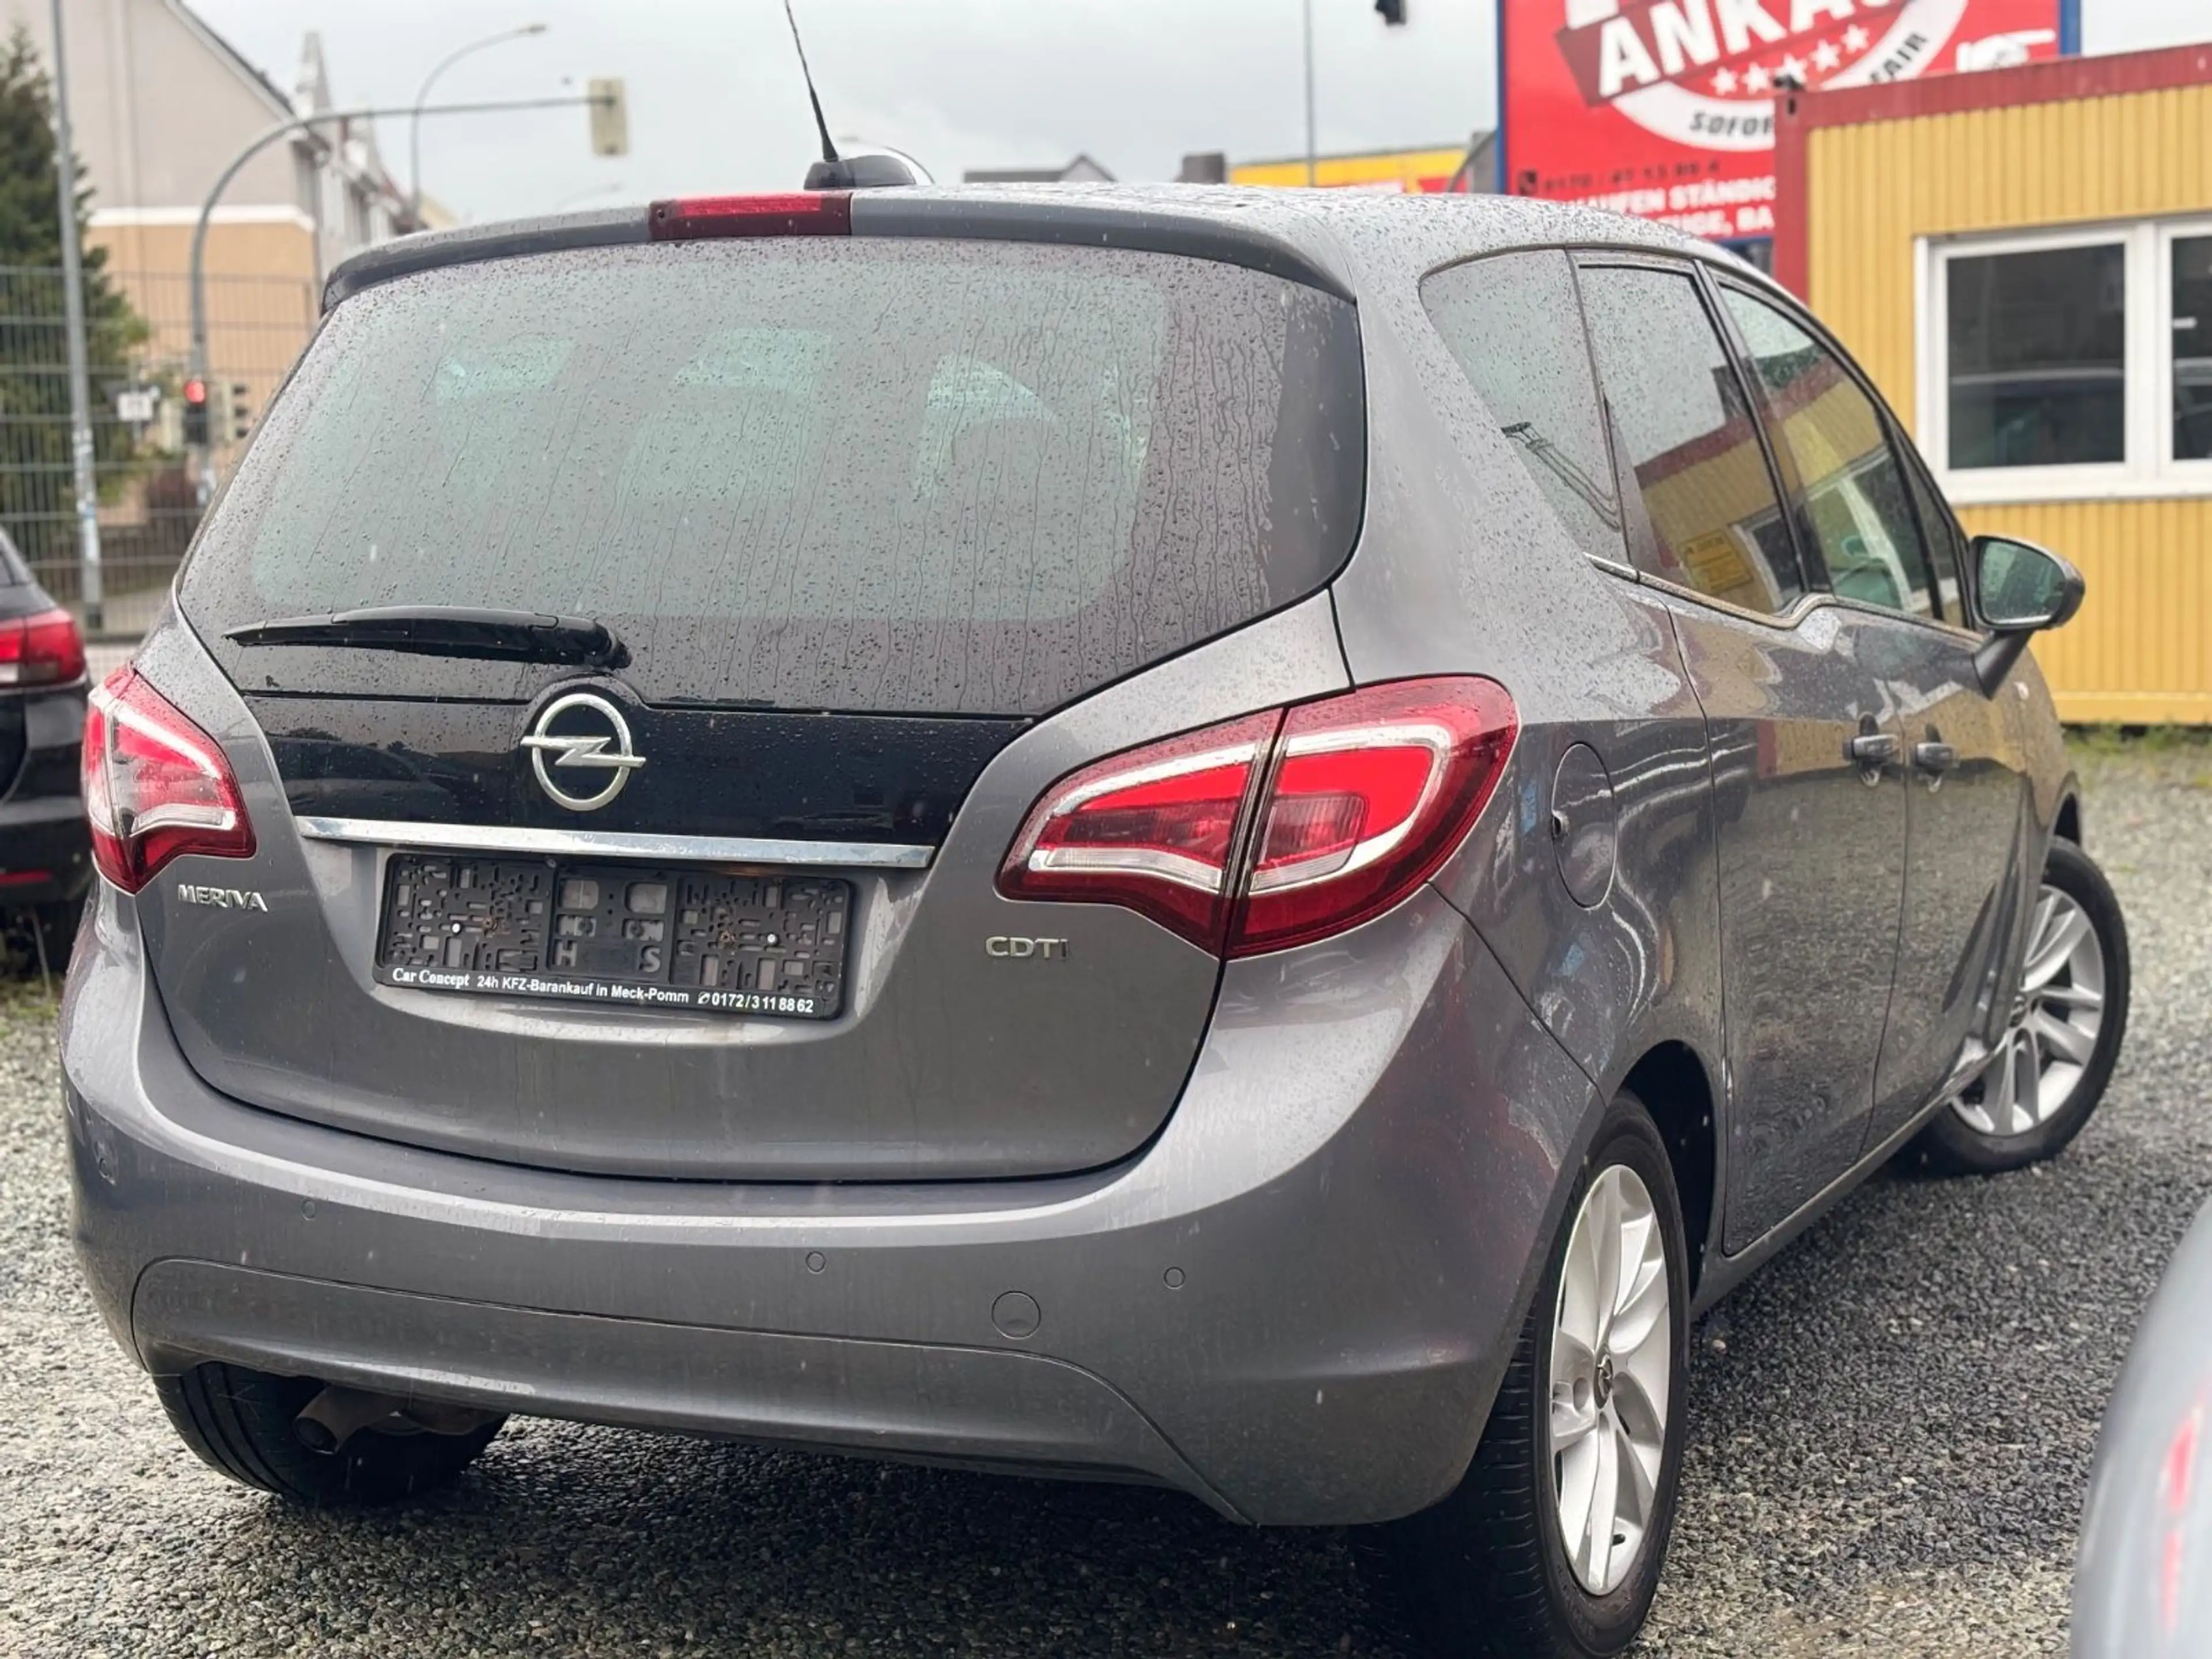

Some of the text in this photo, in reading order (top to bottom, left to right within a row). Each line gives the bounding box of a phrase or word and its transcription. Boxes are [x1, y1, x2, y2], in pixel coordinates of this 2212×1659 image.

[1599, 0, 1895, 98] ANK
[177, 884, 268, 912] MERIVA
[985, 936, 1069, 959] CDTI
[392, 967, 417, 983] Car
[419, 969, 470, 990] Concept
[477, 975, 499, 989] 24h
[502, 976, 594, 995] KFZ-Barankauf
[596, 983, 608, 997] in
[611, 984, 689, 1003] Meck-Pomm
